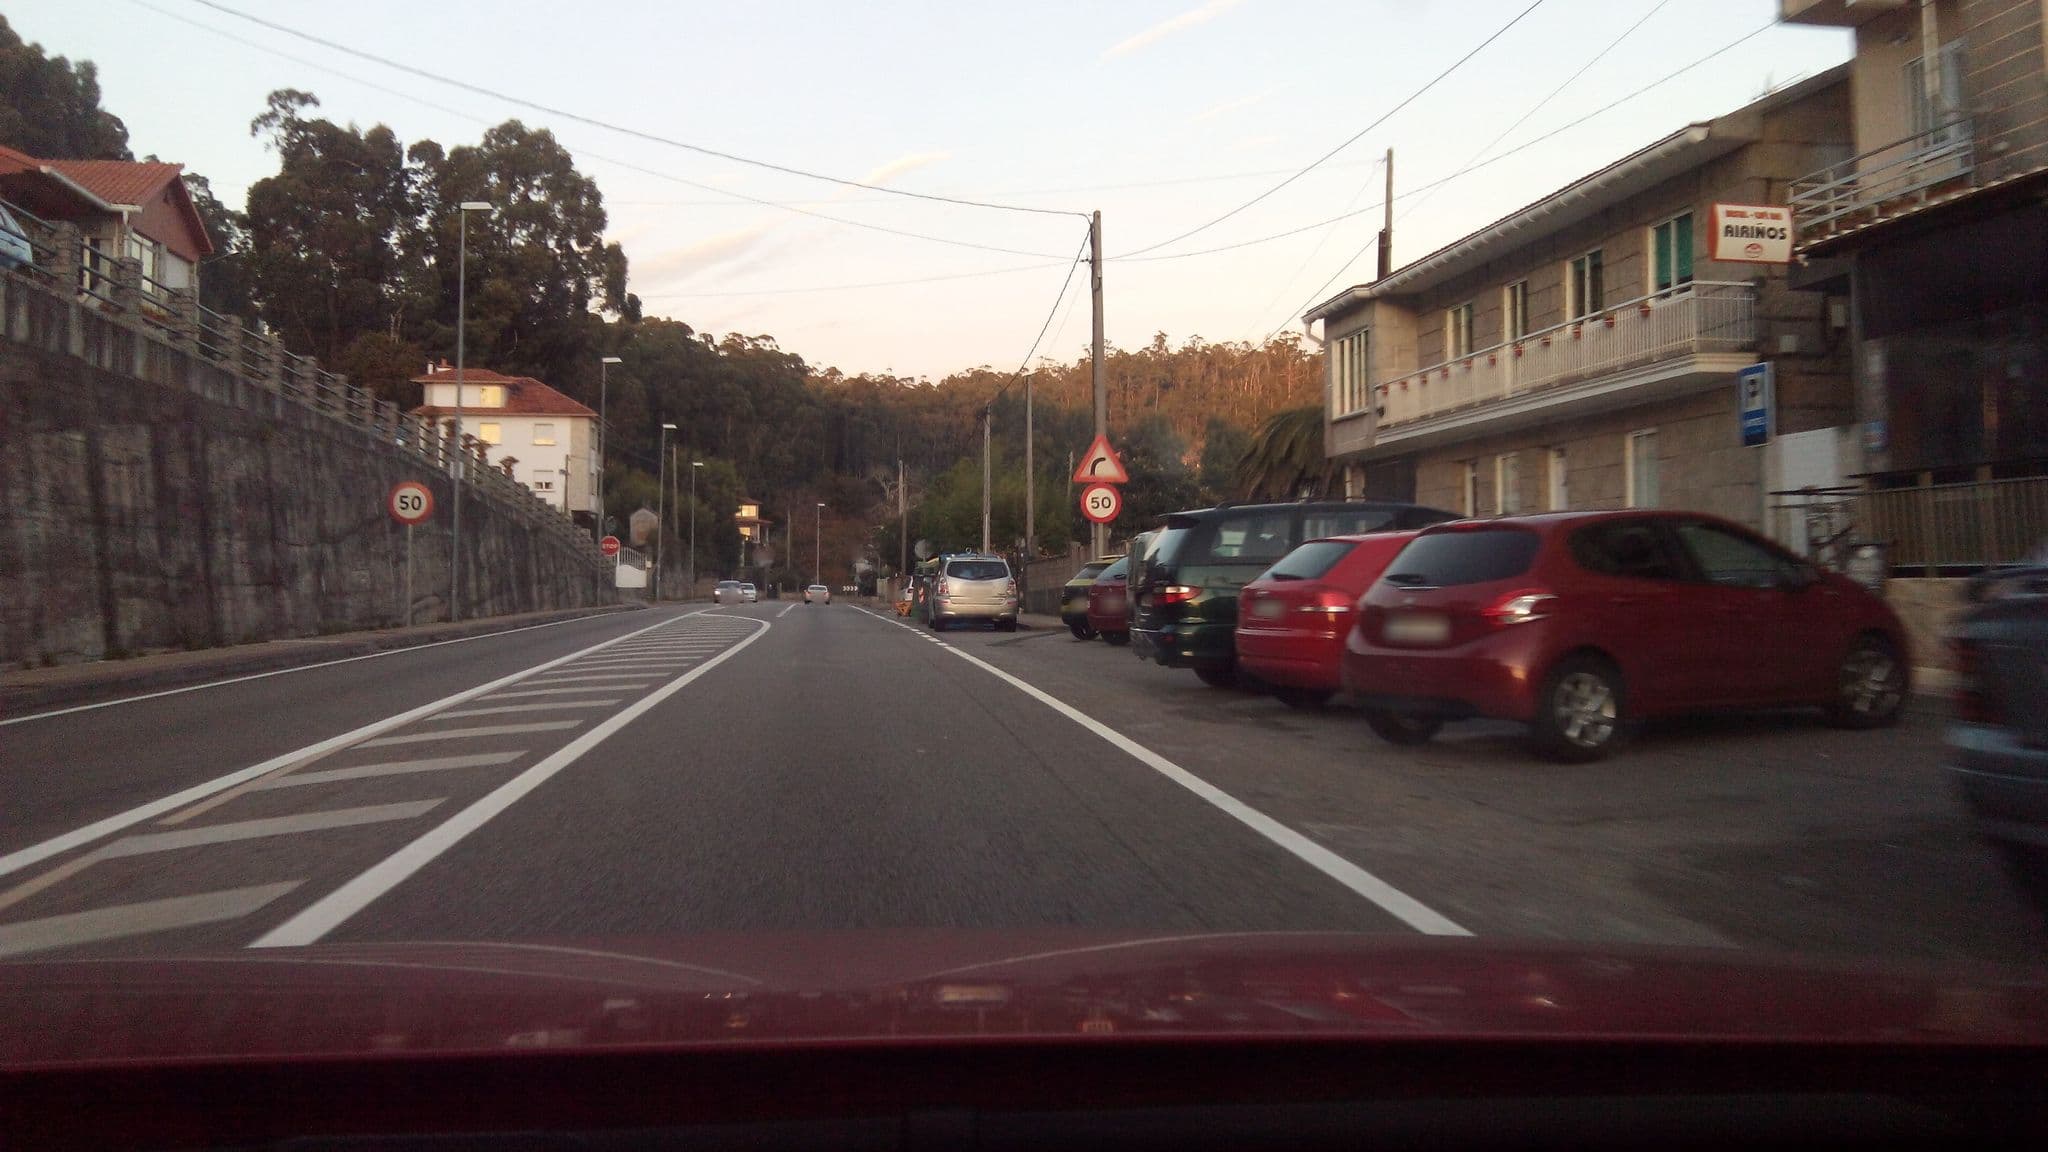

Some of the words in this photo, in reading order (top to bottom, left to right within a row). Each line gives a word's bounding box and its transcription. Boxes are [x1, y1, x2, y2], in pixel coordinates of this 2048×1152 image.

[1724, 222, 1787, 240] AIRIÑOS
[399, 495, 422, 511] 50
[1091, 496, 1112, 510] 50
